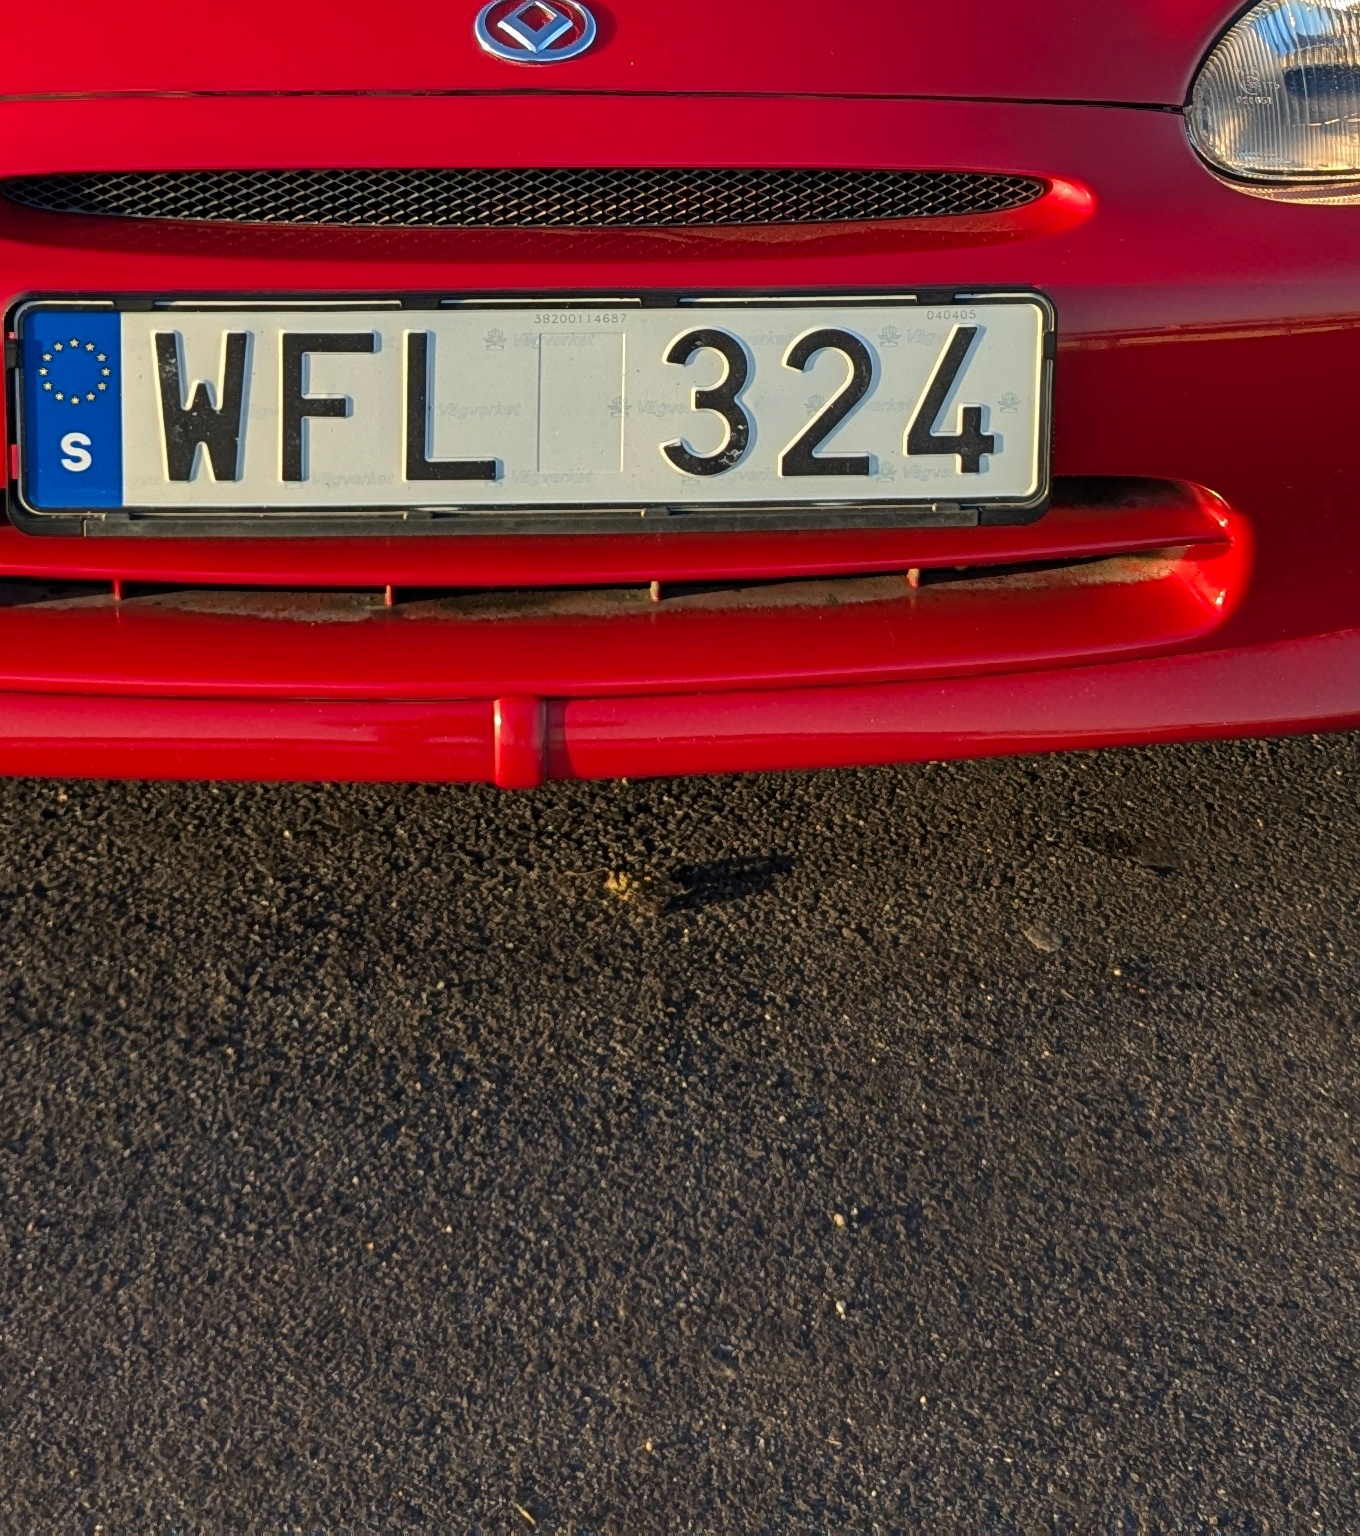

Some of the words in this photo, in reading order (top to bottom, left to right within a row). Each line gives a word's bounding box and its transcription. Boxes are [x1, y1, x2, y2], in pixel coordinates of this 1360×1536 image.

[926, 309, 976, 320] 040405
[60, 431, 92, 472] S
[152, 330, 500, 482] WFL
[662, 324, 998, 477] 324
